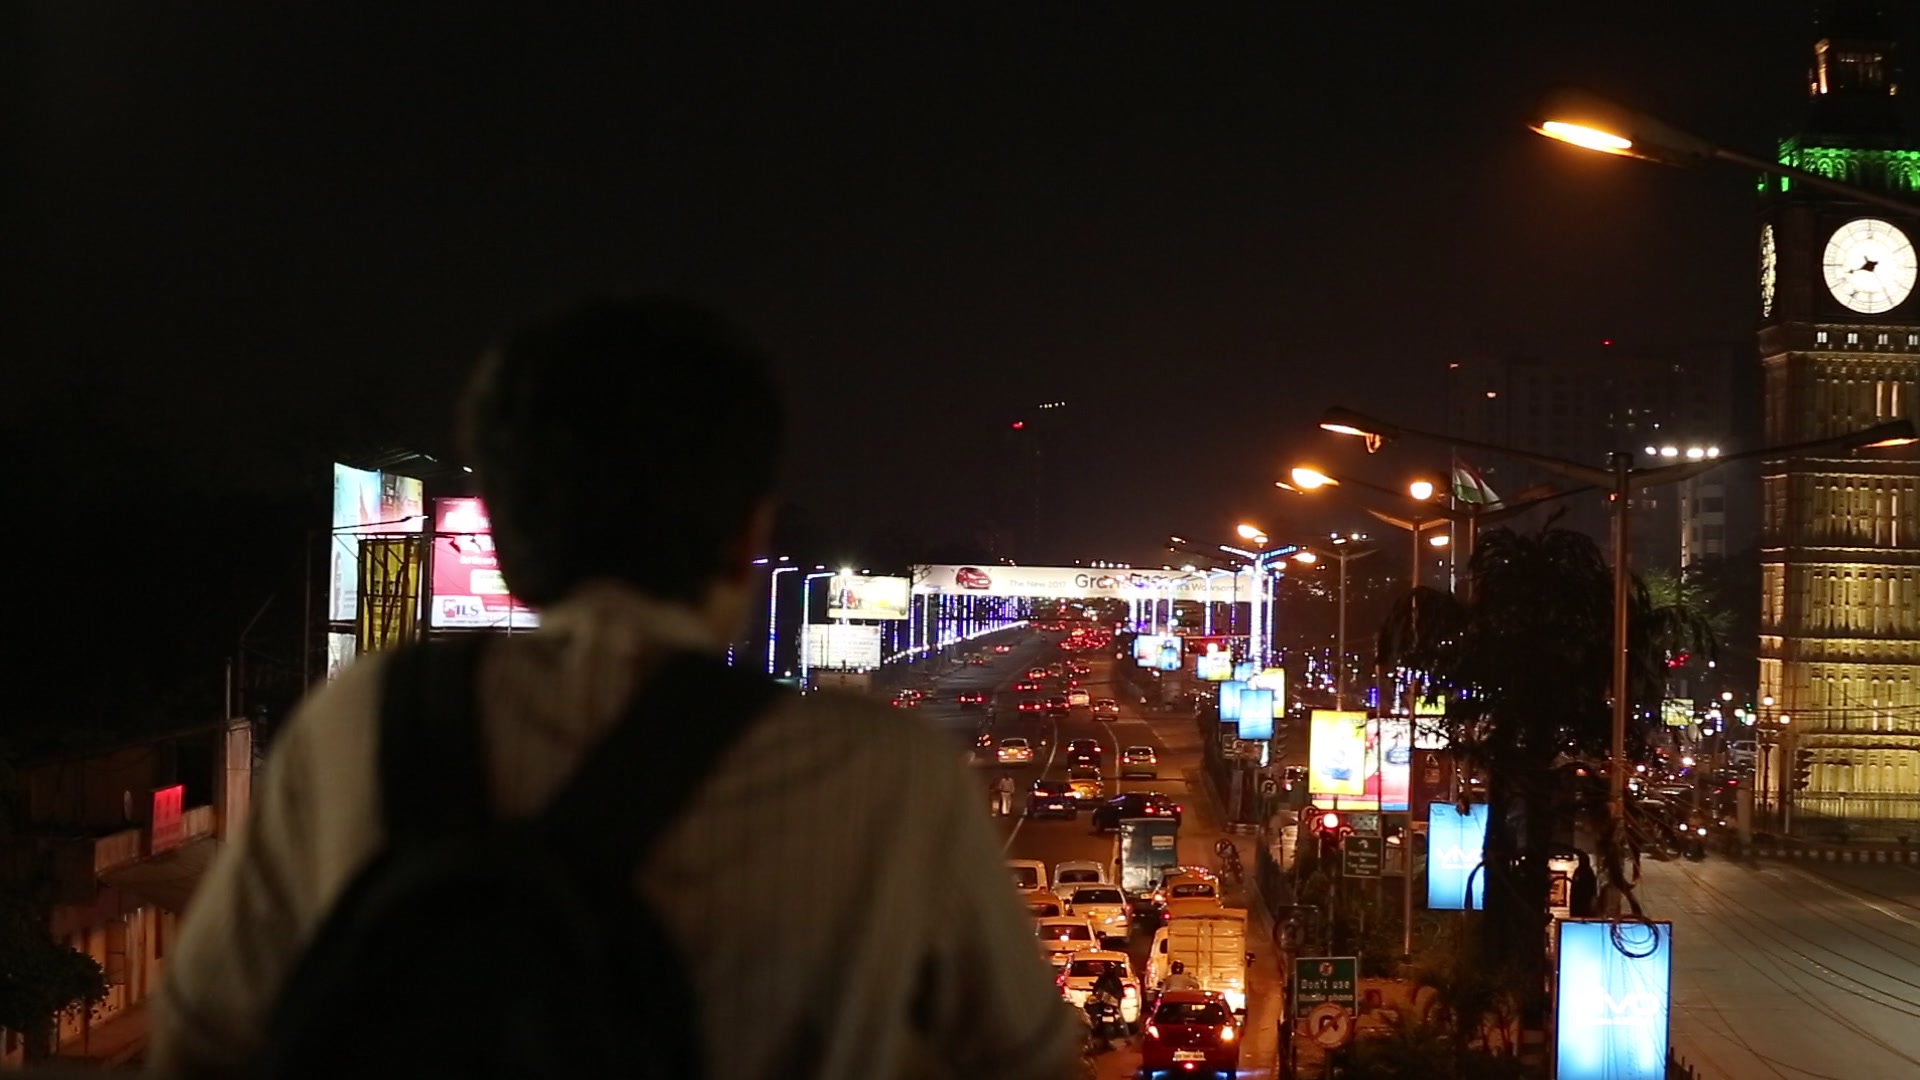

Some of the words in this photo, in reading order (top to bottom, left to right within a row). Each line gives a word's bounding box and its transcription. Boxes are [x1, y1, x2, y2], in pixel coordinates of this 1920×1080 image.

[1009, 579, 1025, 588] The
[1027, 580, 1046, 588] New
[1048, 580, 1066, 589] 2017
[455, 604, 480, 616] ILS
[1301, 979, 1328, 989] Don't
[1332, 981, 1351, 989] use
